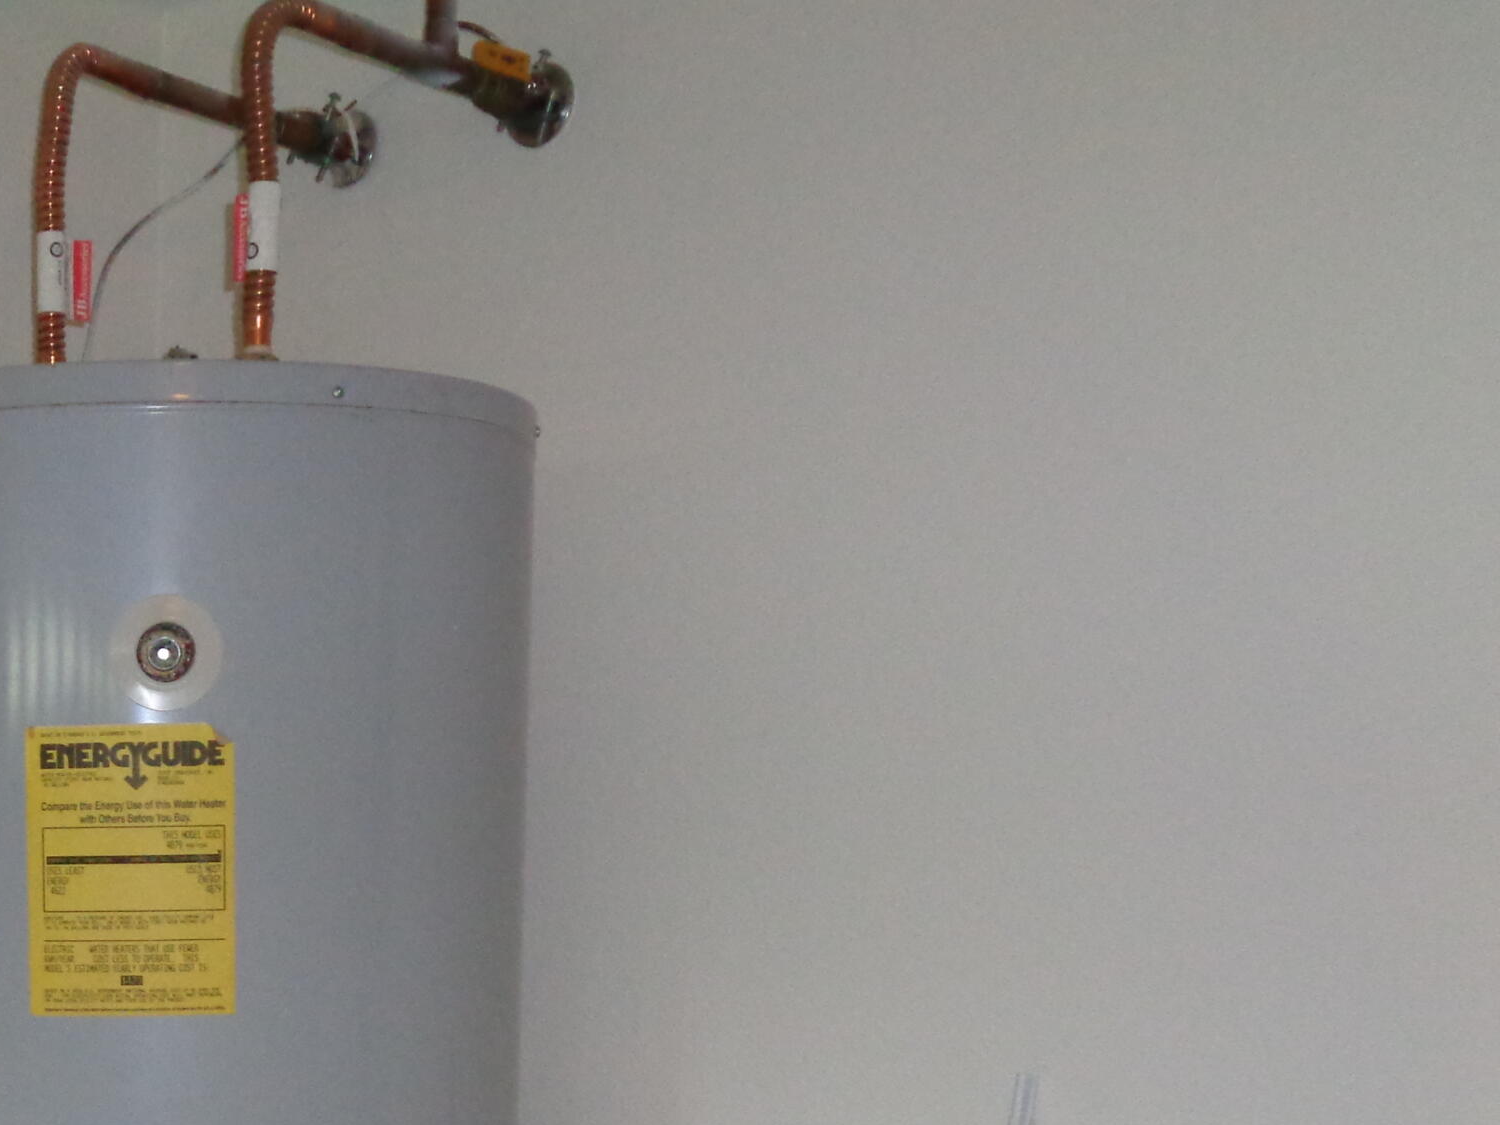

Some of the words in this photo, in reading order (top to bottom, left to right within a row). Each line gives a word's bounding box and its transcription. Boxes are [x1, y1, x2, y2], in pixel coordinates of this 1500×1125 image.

[40, 740, 225, 769] ENERGYGUIDE
[41, 802, 77, 812] Compare
[80, 802, 92, 810] the
[95, 801, 123, 812] Energy
[126, 801, 142, 809] Use
[144, 800, 153, 809] of
[155, 800, 171, 809] this
[173, 800, 197, 809] Water
[199, 799, 226, 808] Heater
[80, 815, 96, 823] with
[99, 814, 125, 823] Others
[128, 813, 154, 823] Before
[156, 813, 172, 822] You
